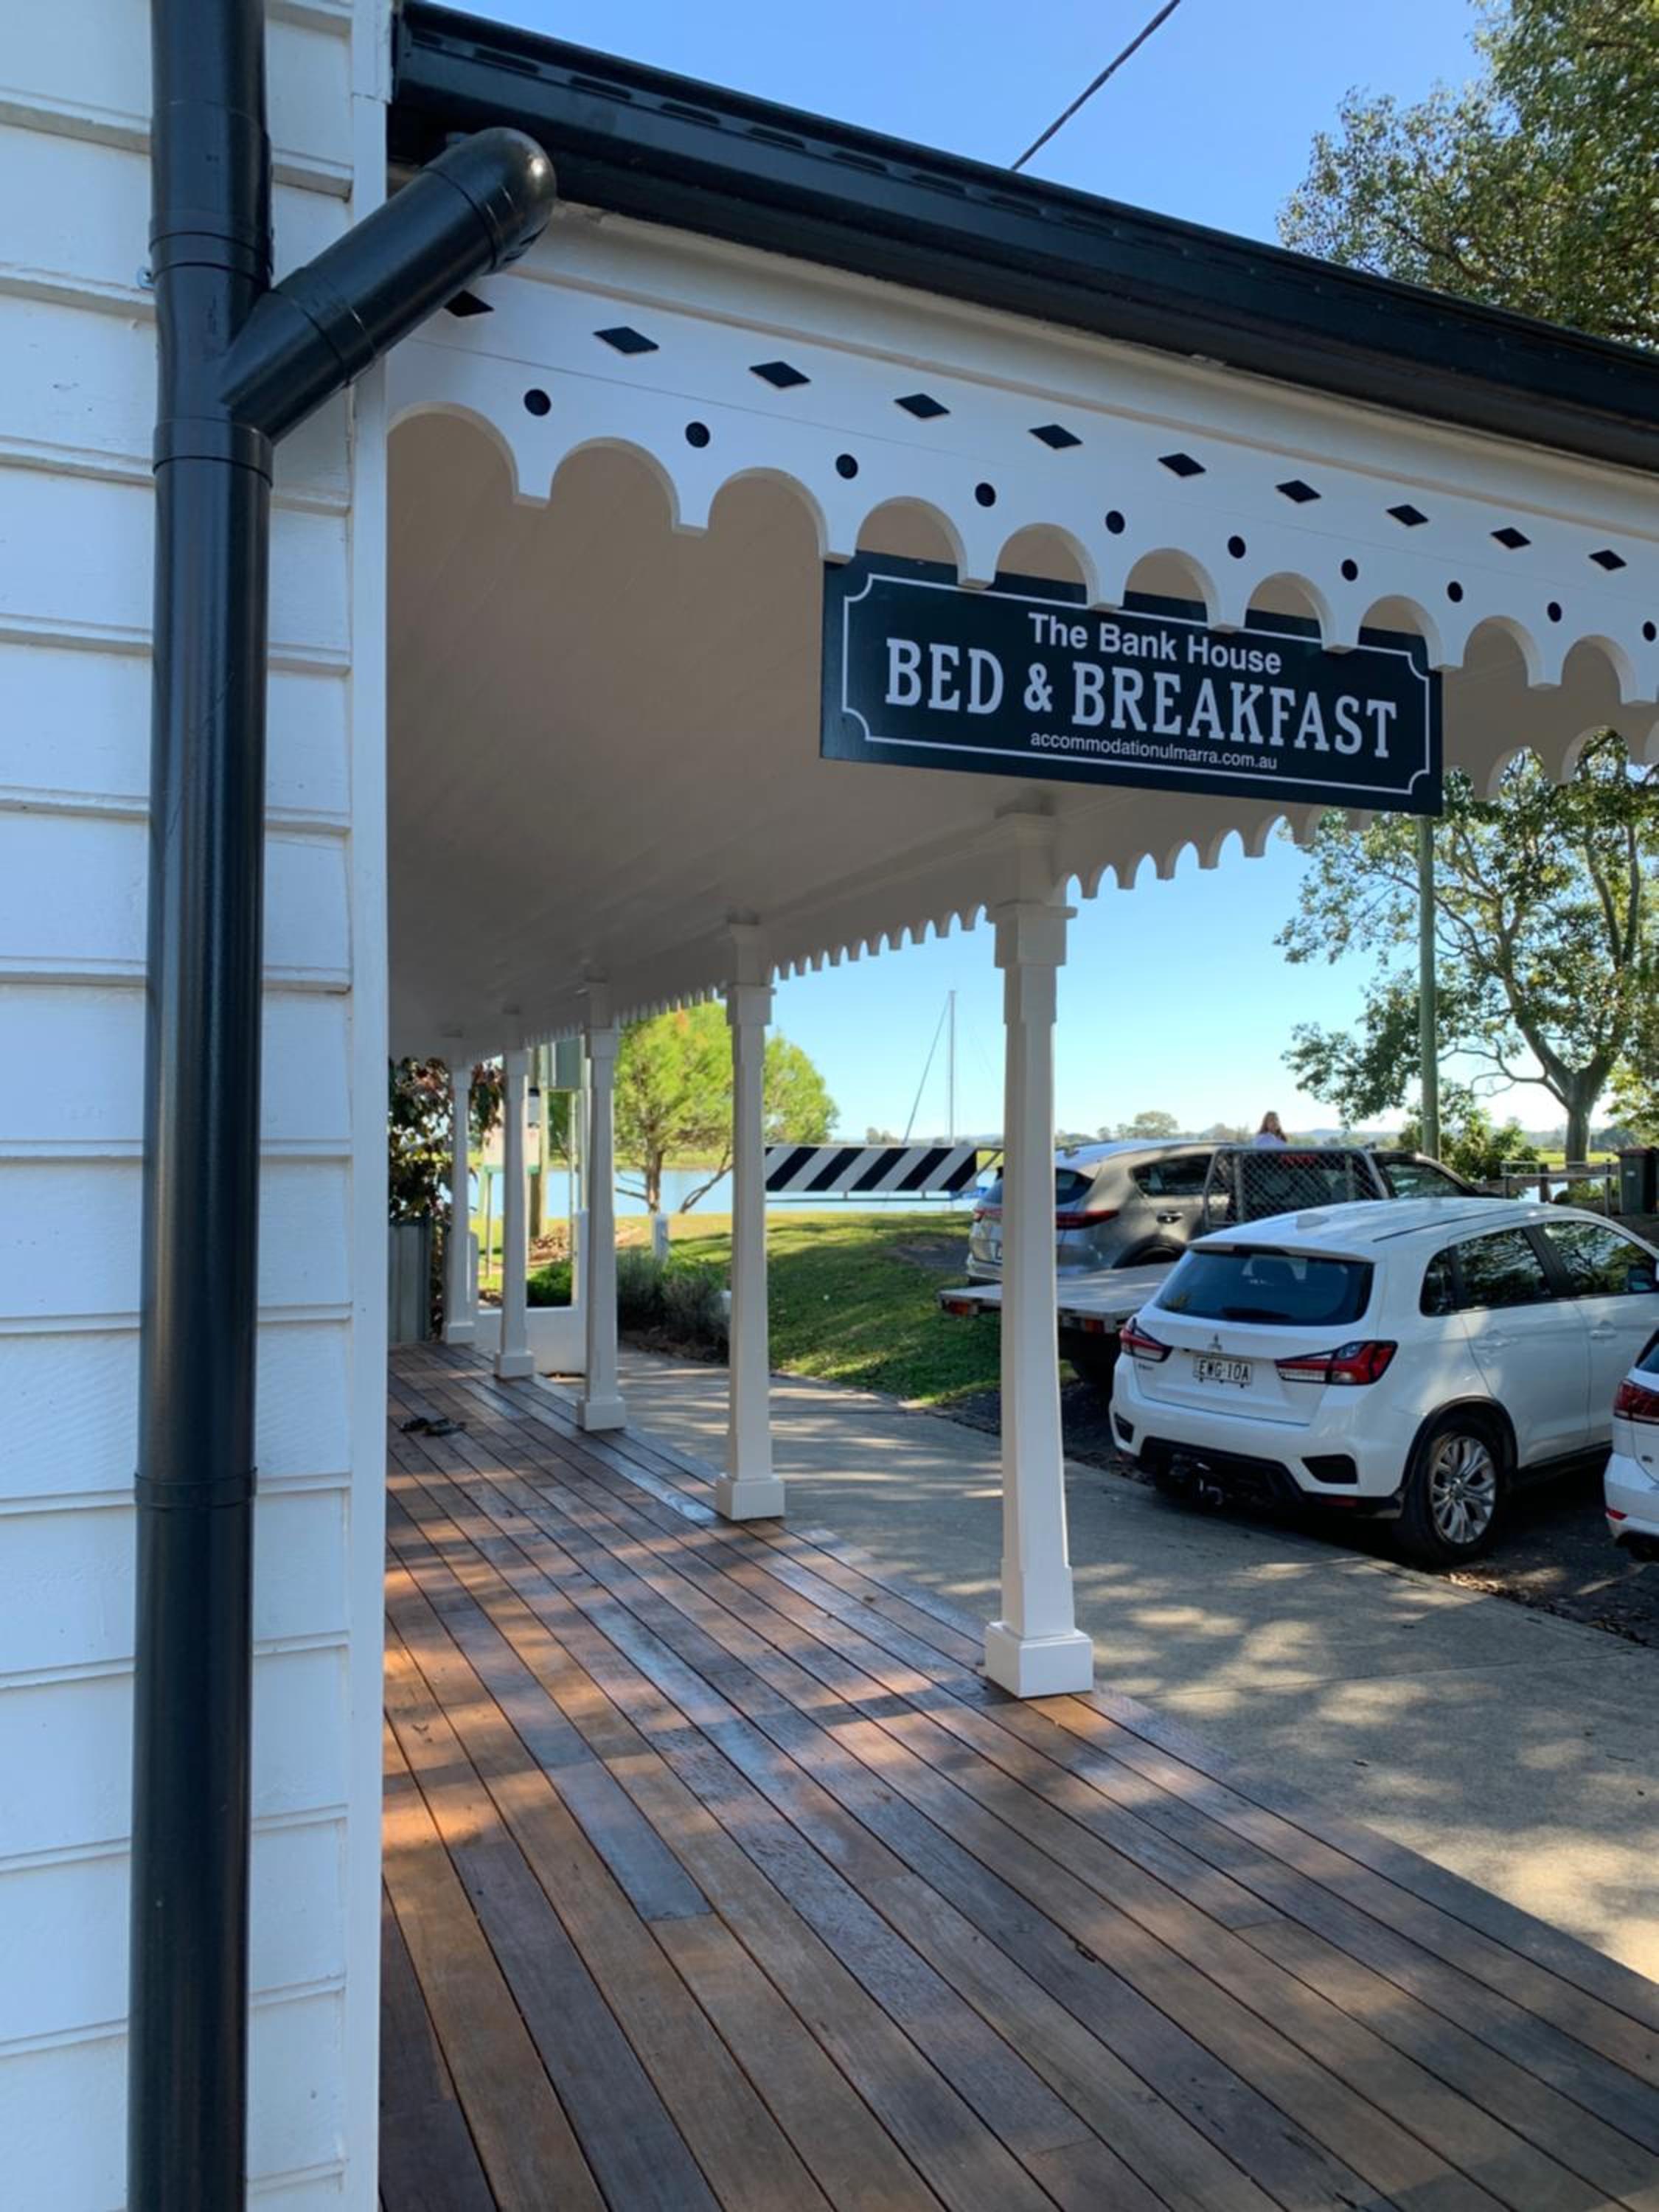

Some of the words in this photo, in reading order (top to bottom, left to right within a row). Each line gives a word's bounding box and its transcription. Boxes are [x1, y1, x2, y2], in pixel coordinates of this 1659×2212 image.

[1029, 611, 1088, 649] The
[1099, 622, 1178, 661] Bank
[1187, 634, 1281, 675] House
[886, 637, 1004, 714] BED
[1023, 662, 1053, 712] &
[1071, 661, 1397, 758] BREAKFAST
[1030, 731, 1277, 770] accommodationulmarra.com.au
